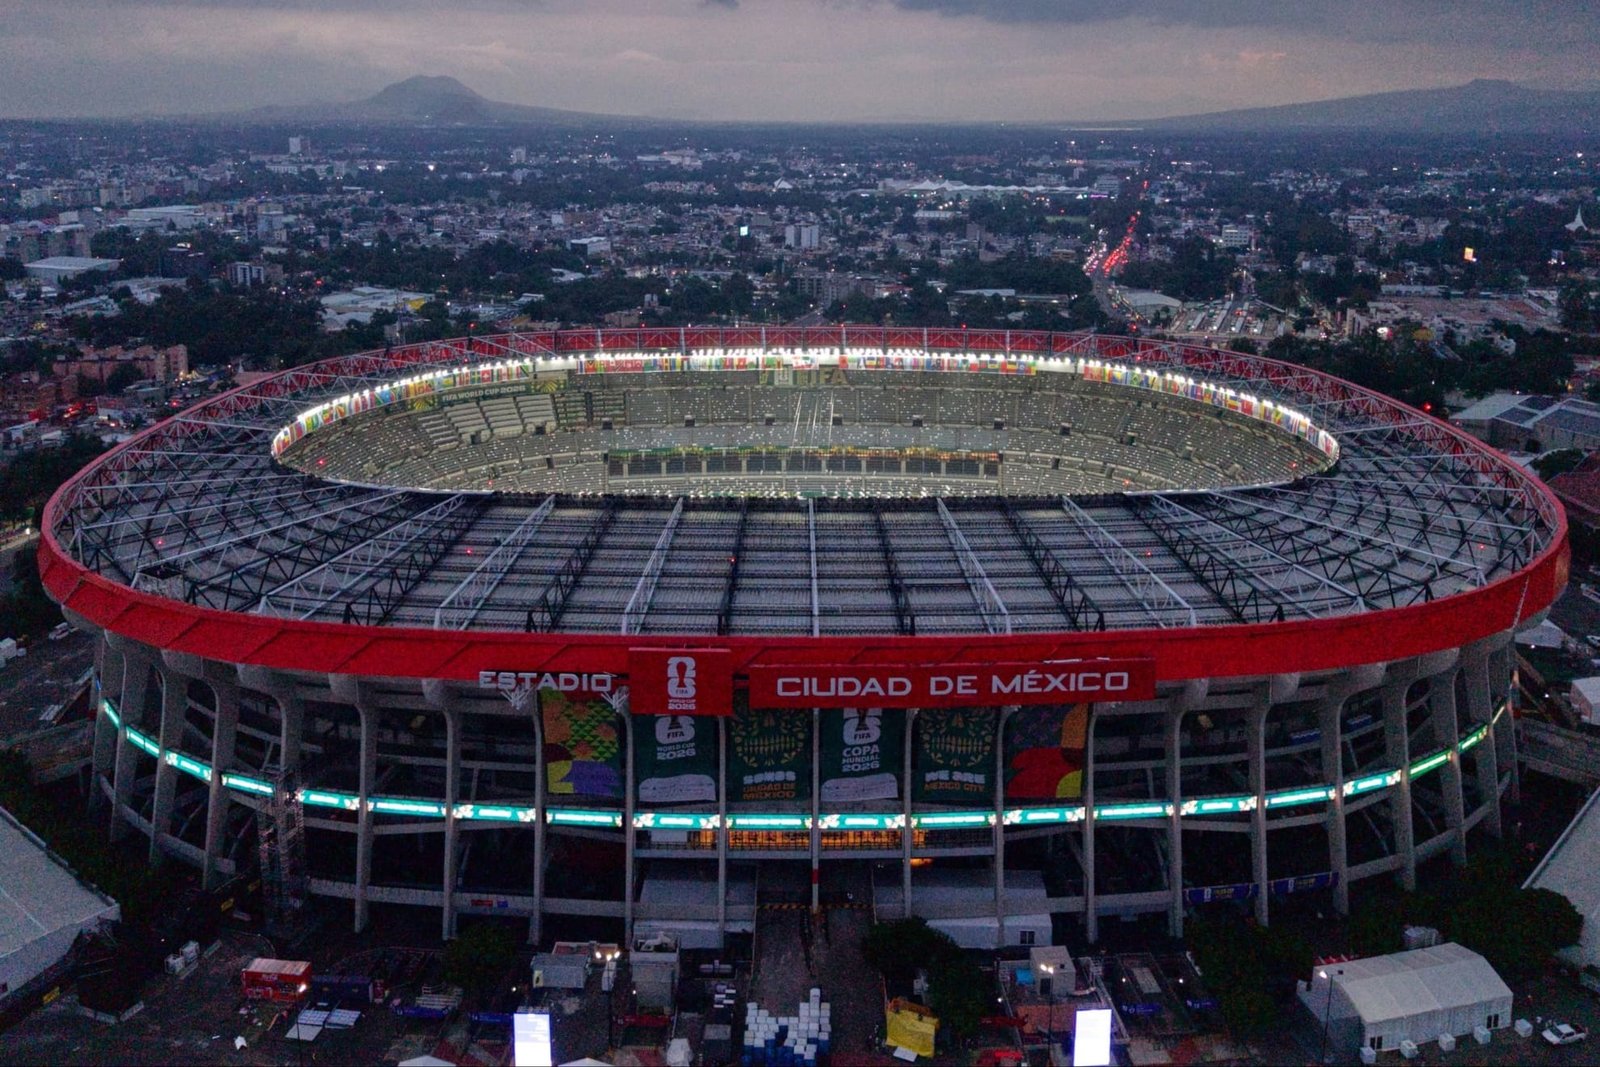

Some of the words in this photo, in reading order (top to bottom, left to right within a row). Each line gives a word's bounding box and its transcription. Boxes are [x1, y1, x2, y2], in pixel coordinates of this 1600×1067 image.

[443, 393, 458, 402] FIFA
[458, 389, 484, 400] WORLD
[484, 388, 500, 396] CUP
[479, 671, 612, 691] ESTADIO
[777, 677, 912, 696] CIUDAD
[929, 675, 978, 695] DE
[991, 669, 1129, 694] MÉXICO
[667, 731, 685, 739] FIFA
[854, 732, 871, 740] FIFA
[656, 744, 681, 752] WORLD
[656, 748, 697, 760] 2026
[842, 744, 880, 757] COPA
[842, 754, 880, 764] MUNDIAL
[842, 760, 880, 773] 2026
